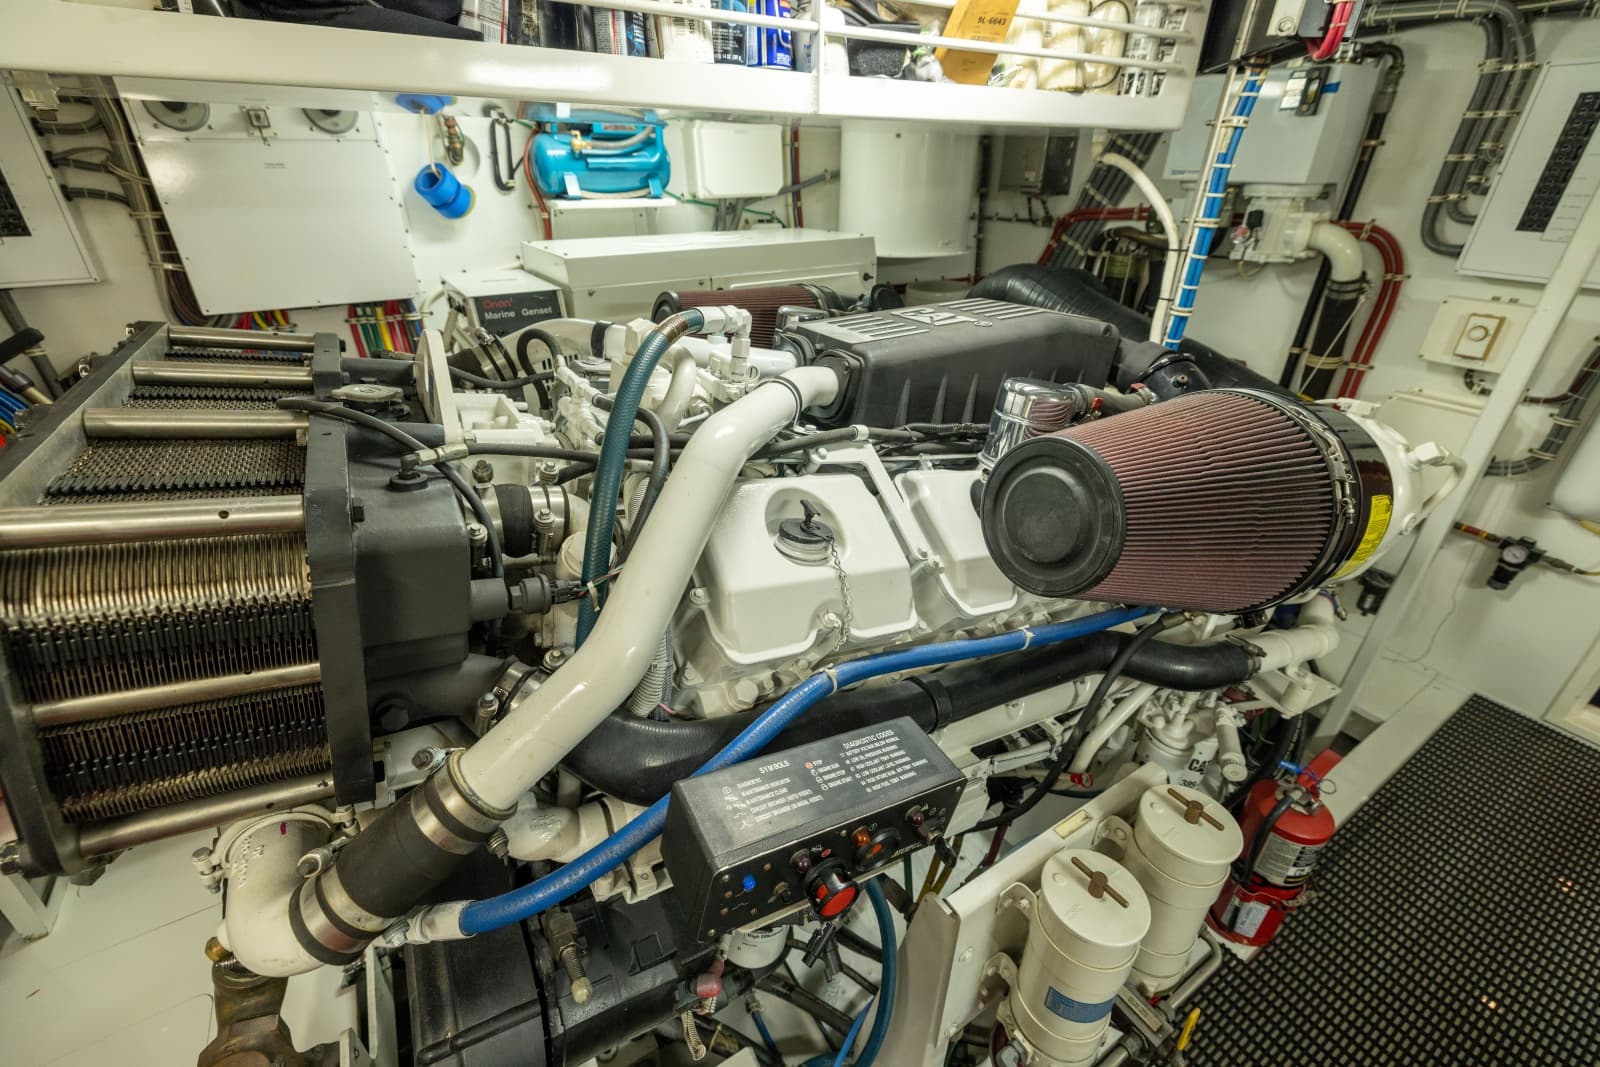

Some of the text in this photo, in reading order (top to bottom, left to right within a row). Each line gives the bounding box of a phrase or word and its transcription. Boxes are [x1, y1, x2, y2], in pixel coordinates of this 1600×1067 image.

[484, 306, 552, 320] Marine Genset
[890, 307, 979, 326] CAT
[843, 729, 895, 749] DIAGNOSTIC CODES
[759, 760, 790, 774] SYMBOLS
